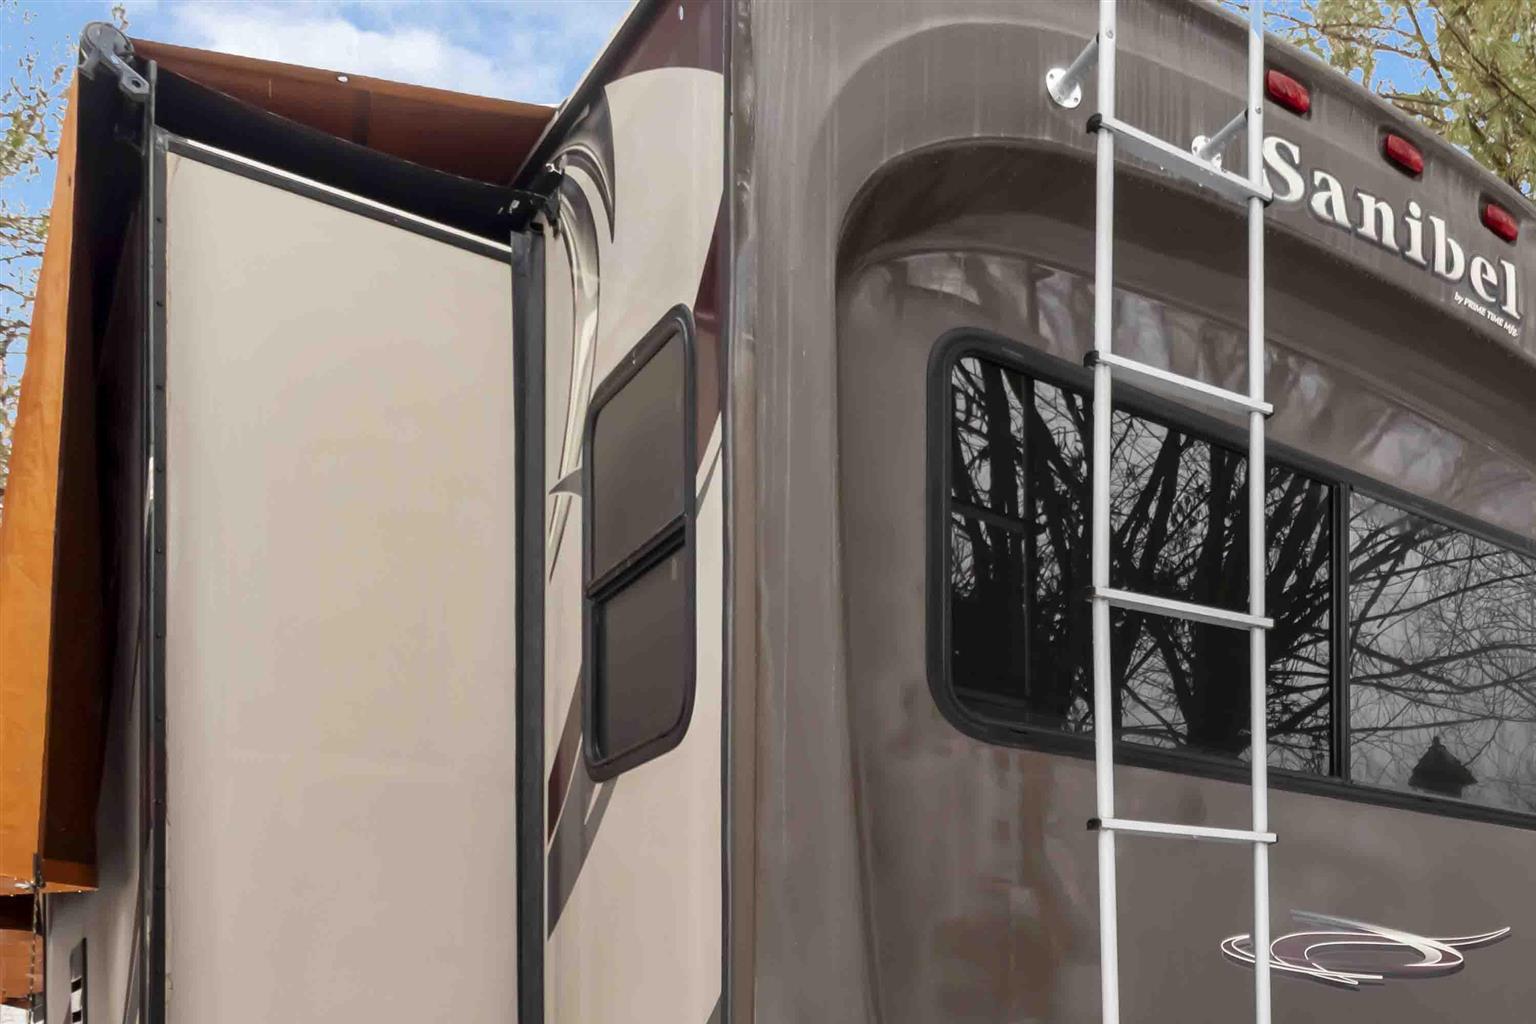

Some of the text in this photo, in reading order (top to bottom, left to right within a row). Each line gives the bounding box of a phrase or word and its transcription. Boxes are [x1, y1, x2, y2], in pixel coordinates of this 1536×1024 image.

[1261, 135, 1521, 320] Sanibel
[1454, 291, 1464, 305] by
[1463, 297, 1487, 317] PRIME
[1487, 310, 1504, 327] TIME
